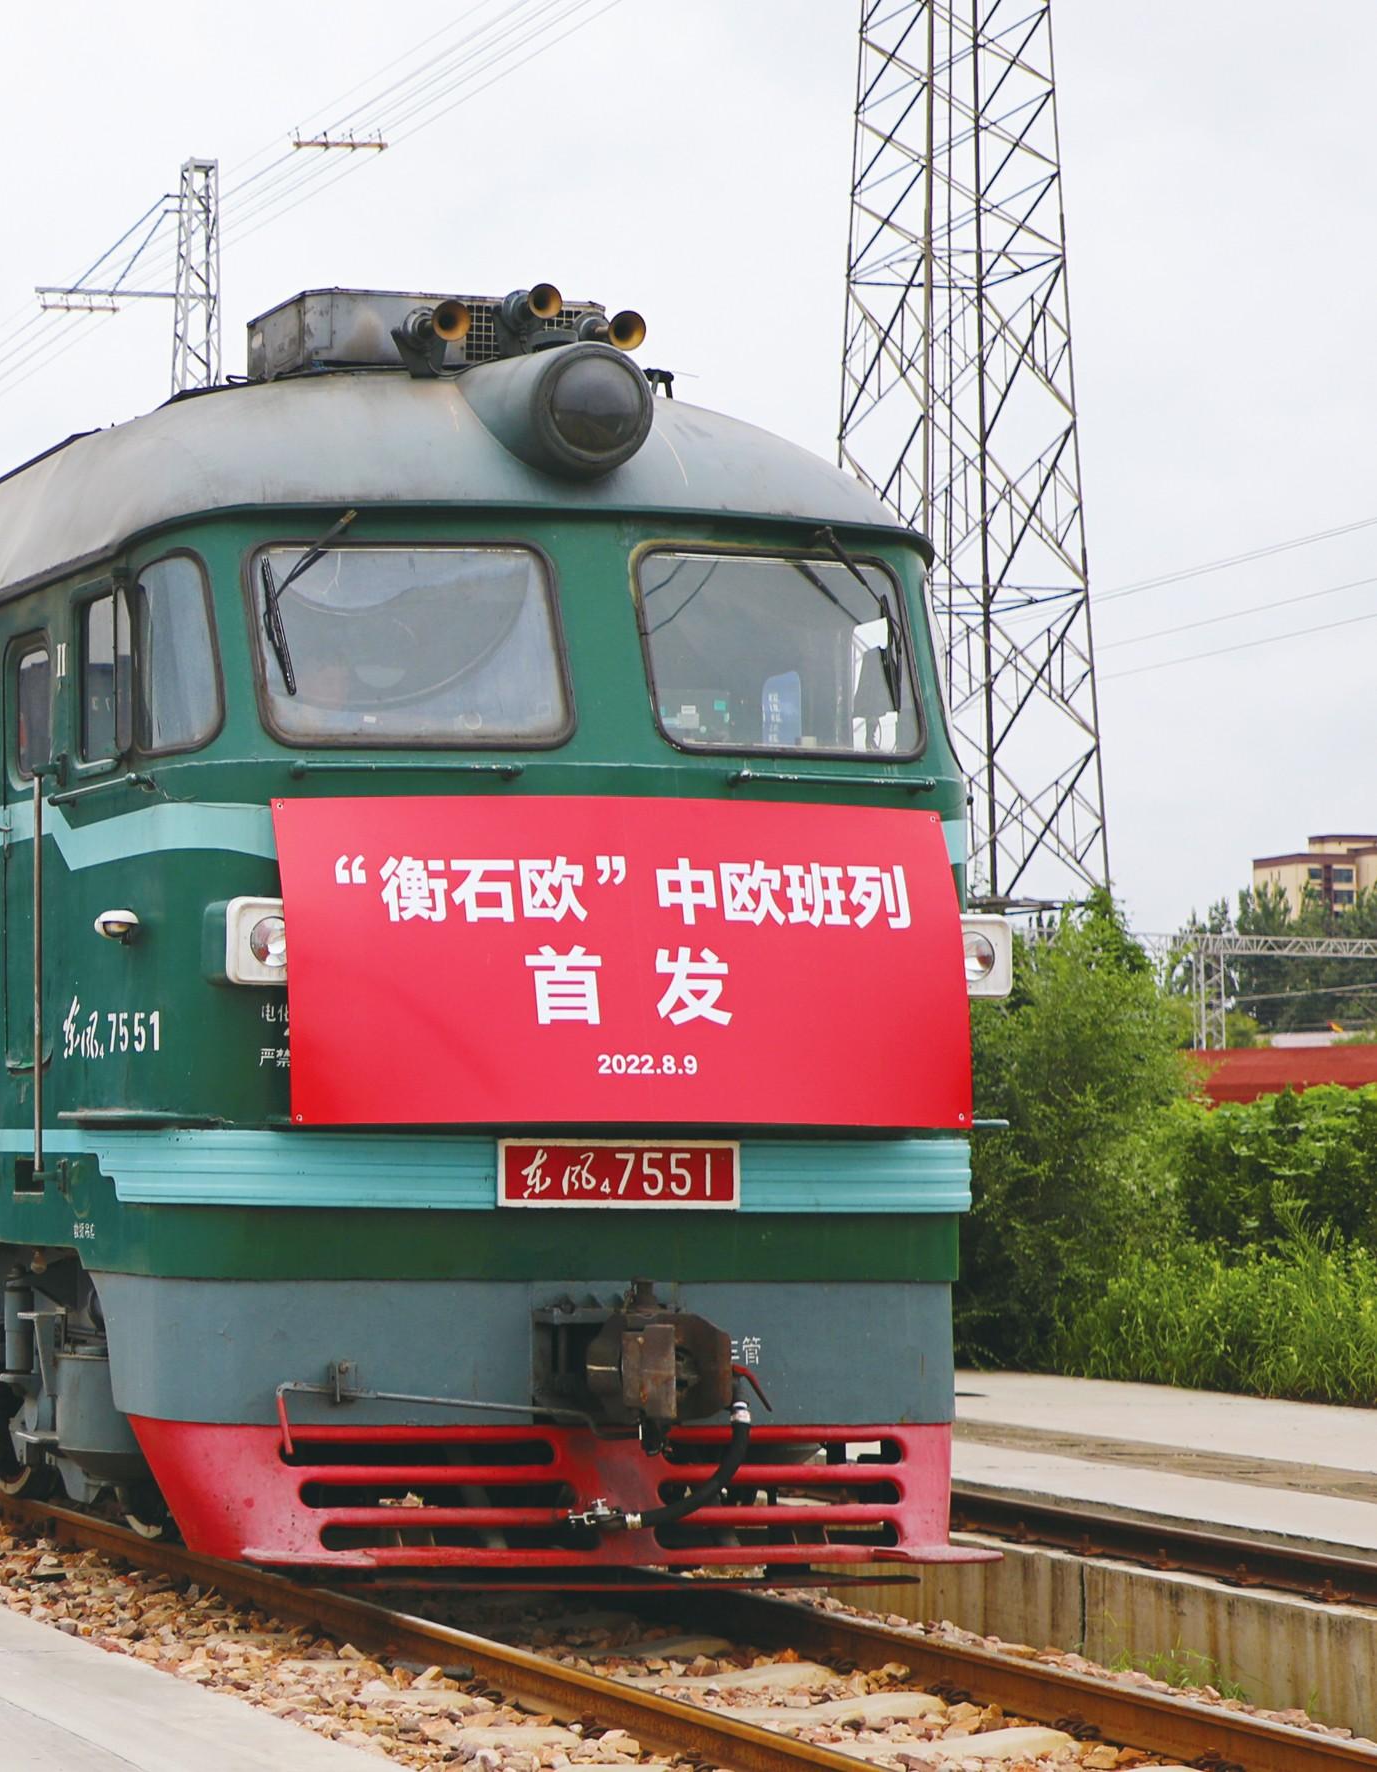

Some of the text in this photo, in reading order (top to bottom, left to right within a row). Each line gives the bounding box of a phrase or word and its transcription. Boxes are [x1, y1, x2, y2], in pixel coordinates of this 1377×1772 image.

[655, 857, 912, 929] 中欧班列
[524, 944, 733, 1026] 首发
[107, 1010, 160, 1053] 7551
[597, 1054, 698, 1076] 2022.8.9
[615, 1152, 711, 1196] 7551
